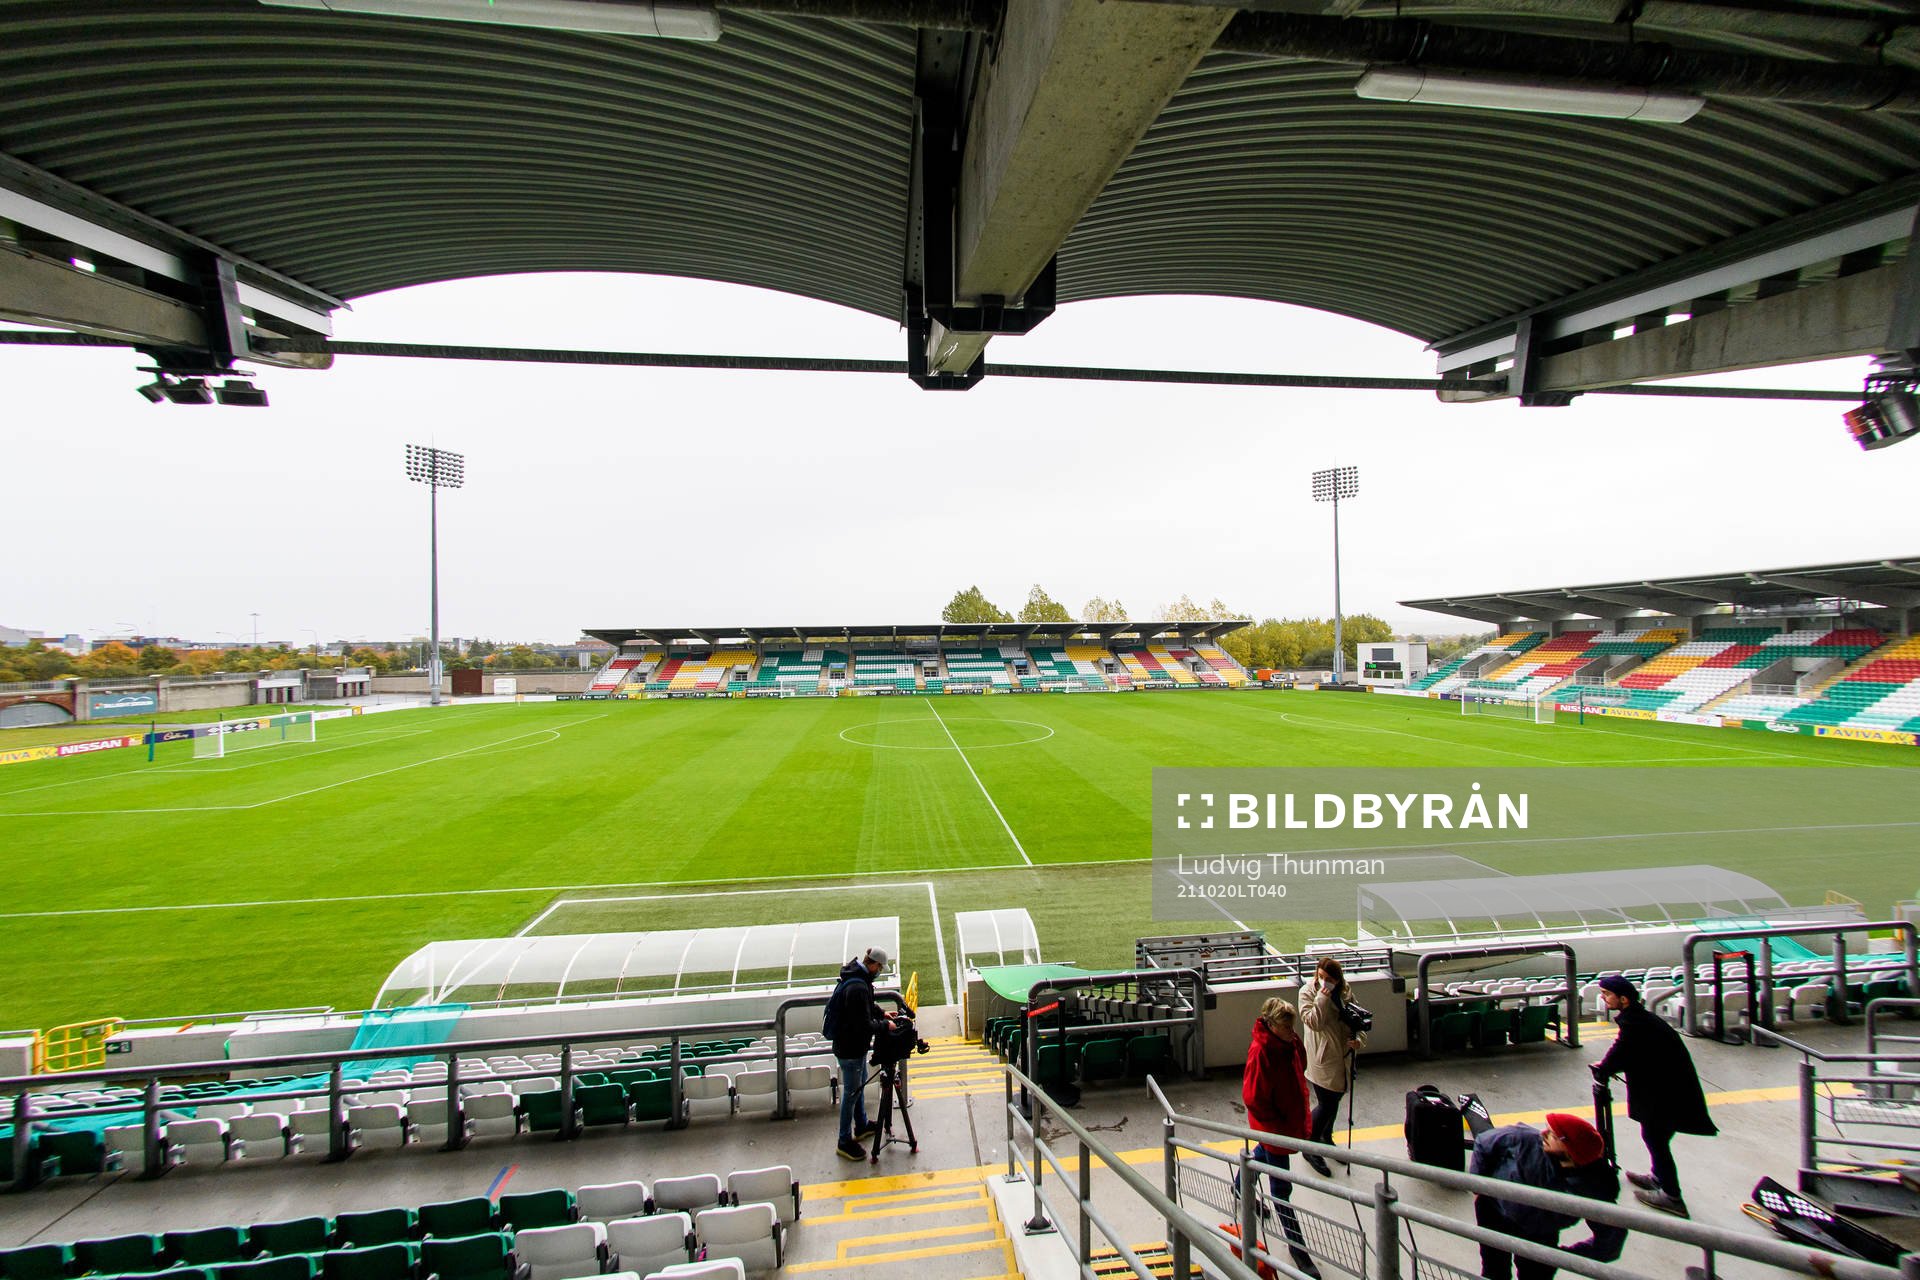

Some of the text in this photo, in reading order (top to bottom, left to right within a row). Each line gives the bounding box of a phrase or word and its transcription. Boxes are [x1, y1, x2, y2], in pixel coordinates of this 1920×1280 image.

[1560, 704, 1600, 715] NISSAN
[1610, 708, 1640, 717] AVIVA
[1832, 728, 1884, 740] AVIVA
[61, 739, 122, 755] NISSAN
